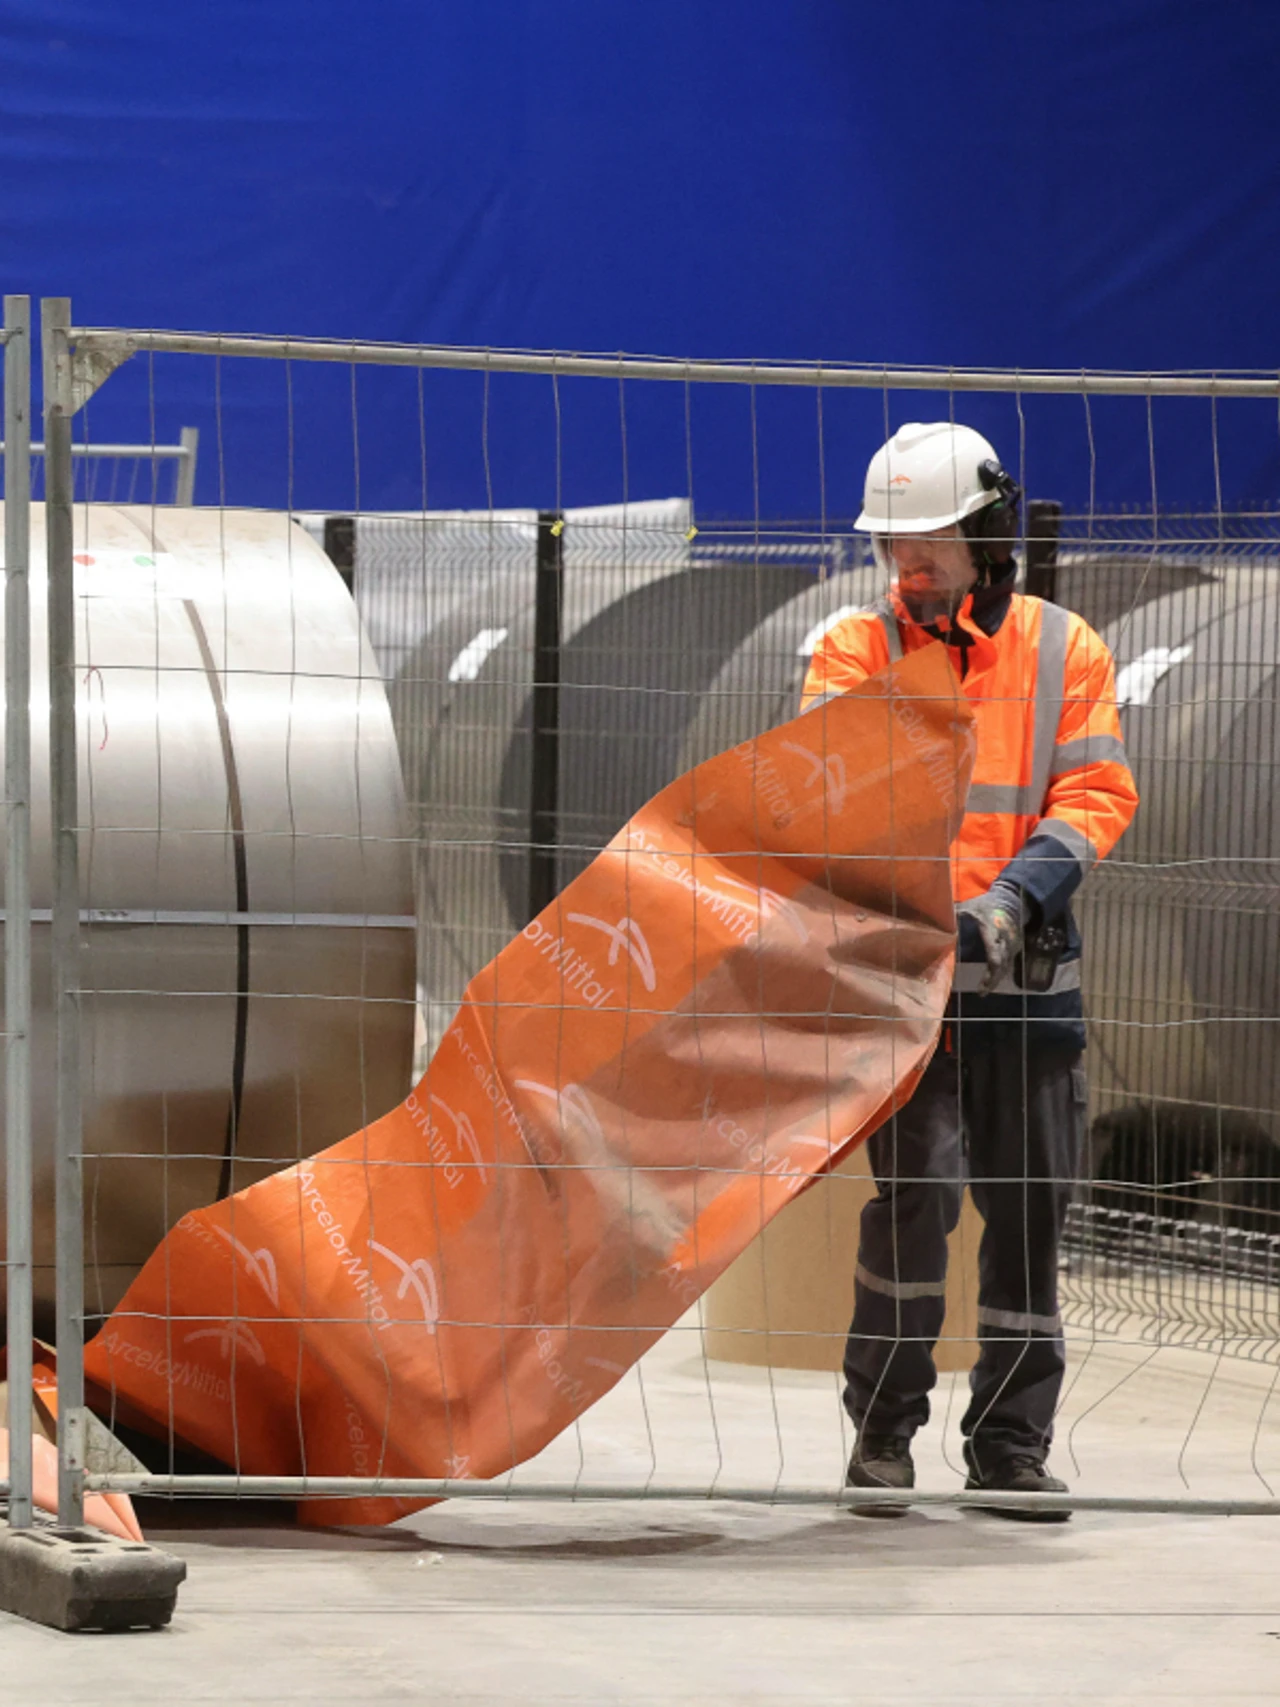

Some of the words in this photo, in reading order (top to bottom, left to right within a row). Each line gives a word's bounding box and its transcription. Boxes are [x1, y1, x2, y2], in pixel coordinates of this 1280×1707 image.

[734, 740, 803, 826] orMittal
[522, 919, 615, 1010] orMittal
[404, 1094, 464, 1189] orMittal
[292, 1171, 393, 1333] ArcelorMittal
